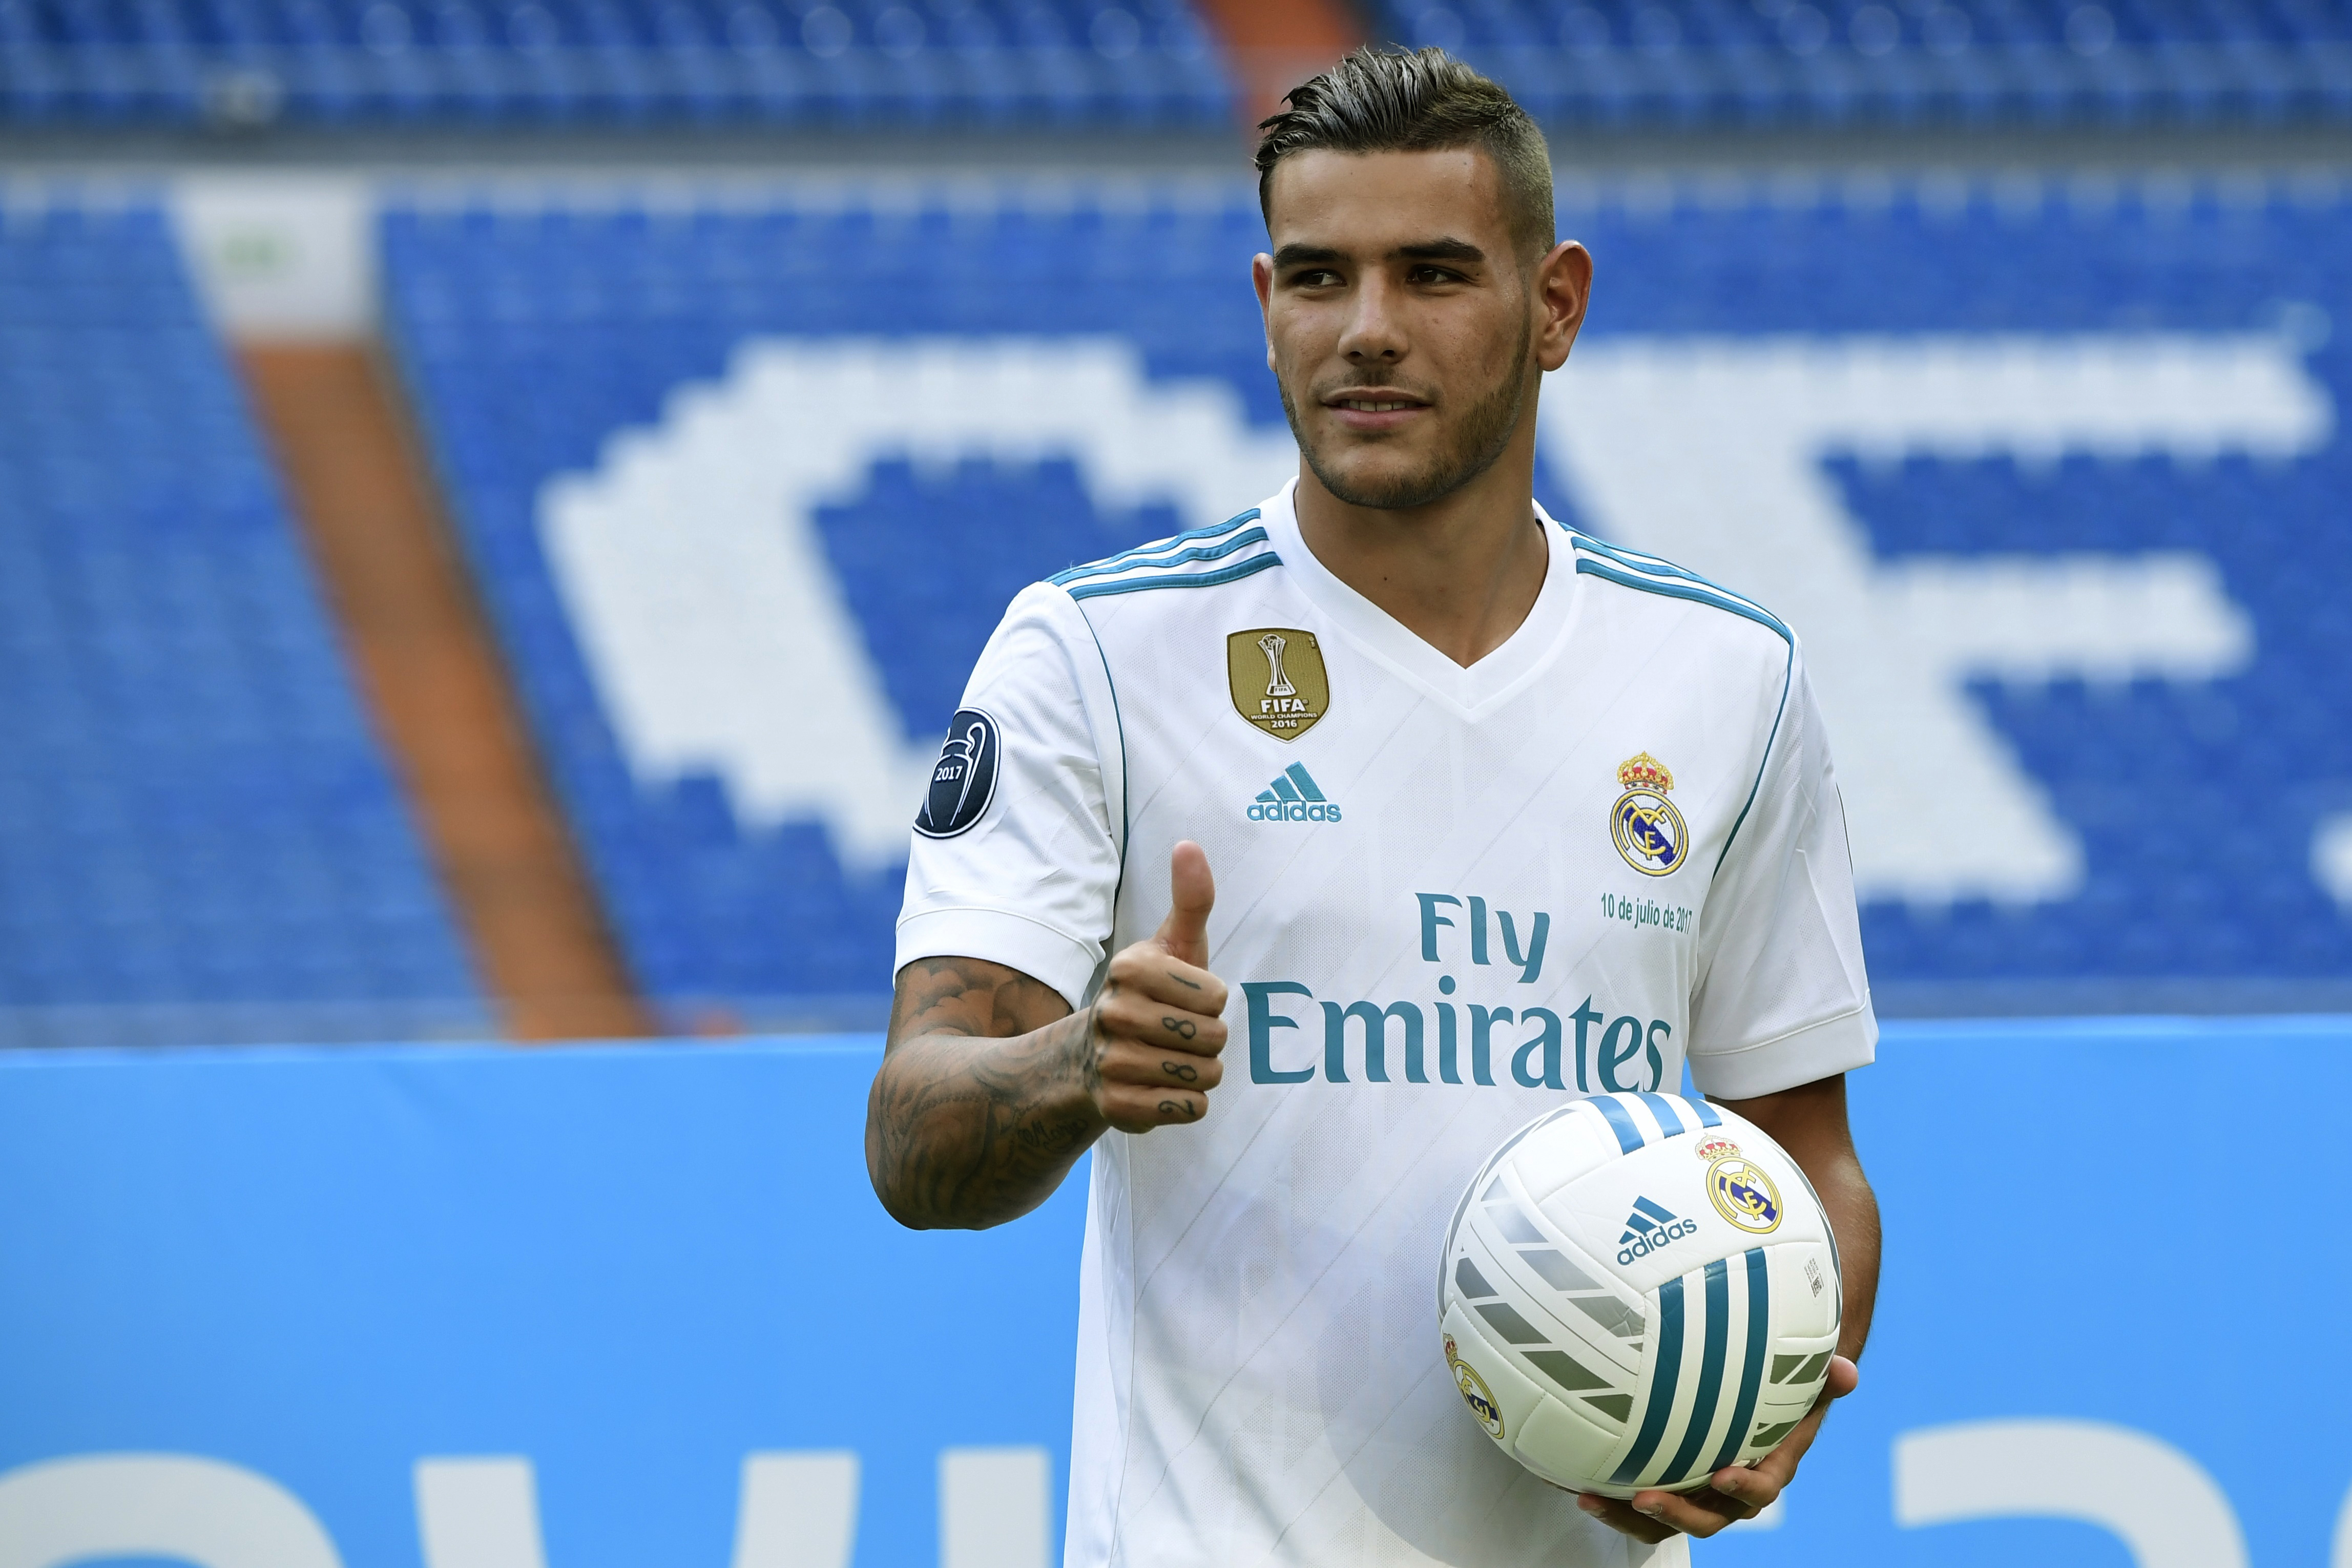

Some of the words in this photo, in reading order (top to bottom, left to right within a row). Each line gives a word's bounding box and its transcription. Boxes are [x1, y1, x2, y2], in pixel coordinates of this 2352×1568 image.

[1261, 698, 1306, 713] FIFA
[1271, 720, 1298, 728] 2016
[935, 766, 963, 781] 2017
[1246, 800, 1342, 823] adidas
[1601, 892, 1615, 918] 10
[1618, 895, 1633, 921] de
[1634, 897, 1660, 929] julio
[1663, 903, 1674, 929] de
[1675, 906, 1693, 935] 2017
[1414, 892, 1550, 984] Fly
[1240, 974, 1671, 1094] Emirates
[1616, 1219, 1698, 1266] adidas
